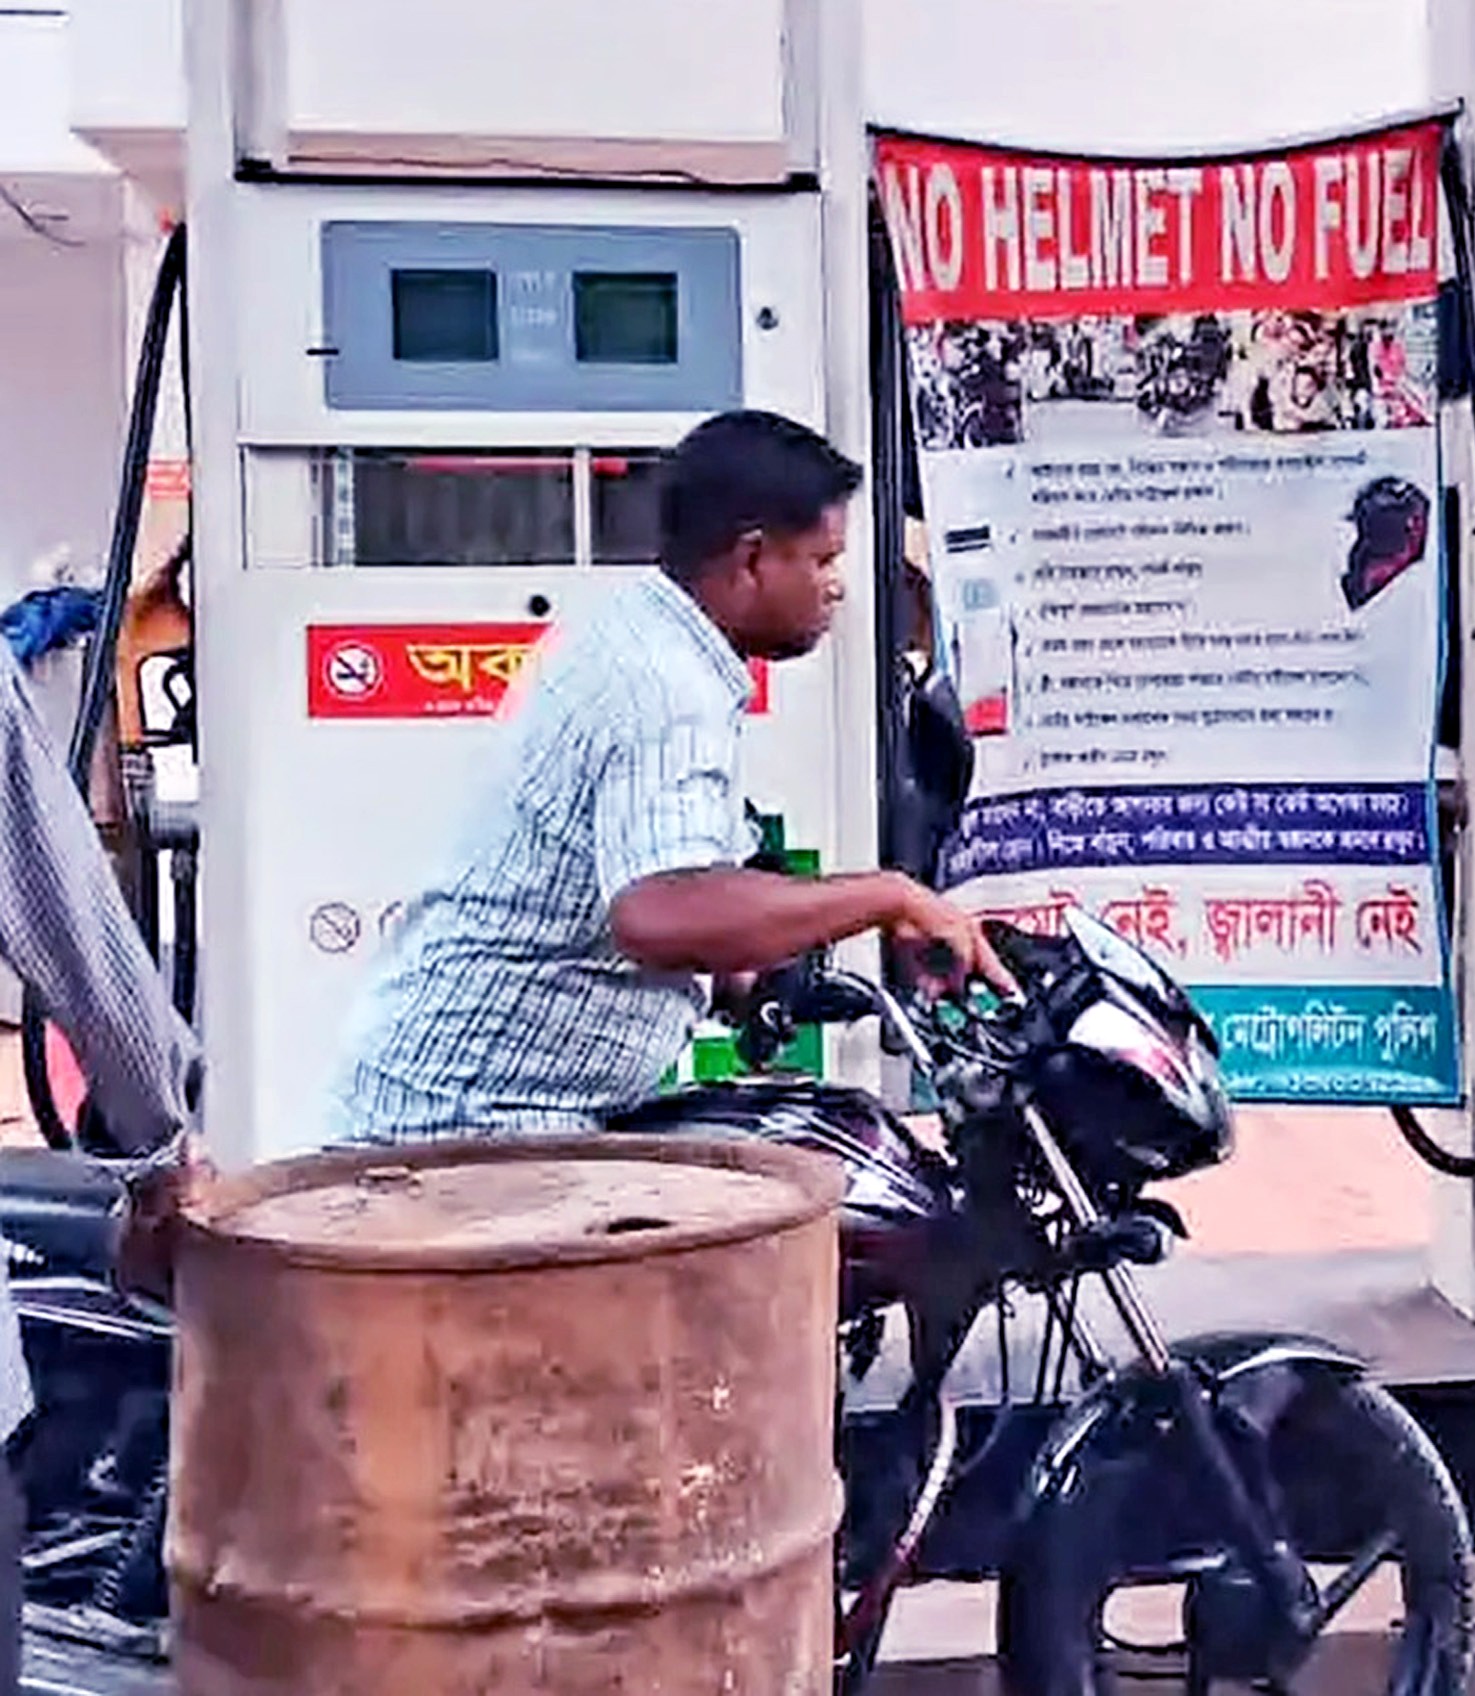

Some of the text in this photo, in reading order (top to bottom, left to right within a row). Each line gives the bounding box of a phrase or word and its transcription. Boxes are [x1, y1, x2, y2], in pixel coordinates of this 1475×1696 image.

[875, 147, 1431, 292] NO HELMET NO FUEL
[1202, 878, 1343, 963] জ্বালানী
[1355, 880, 1423, 954] নেই
[1222, 998, 1438, 1062] মেট্রোপলিটন পুলিশ
